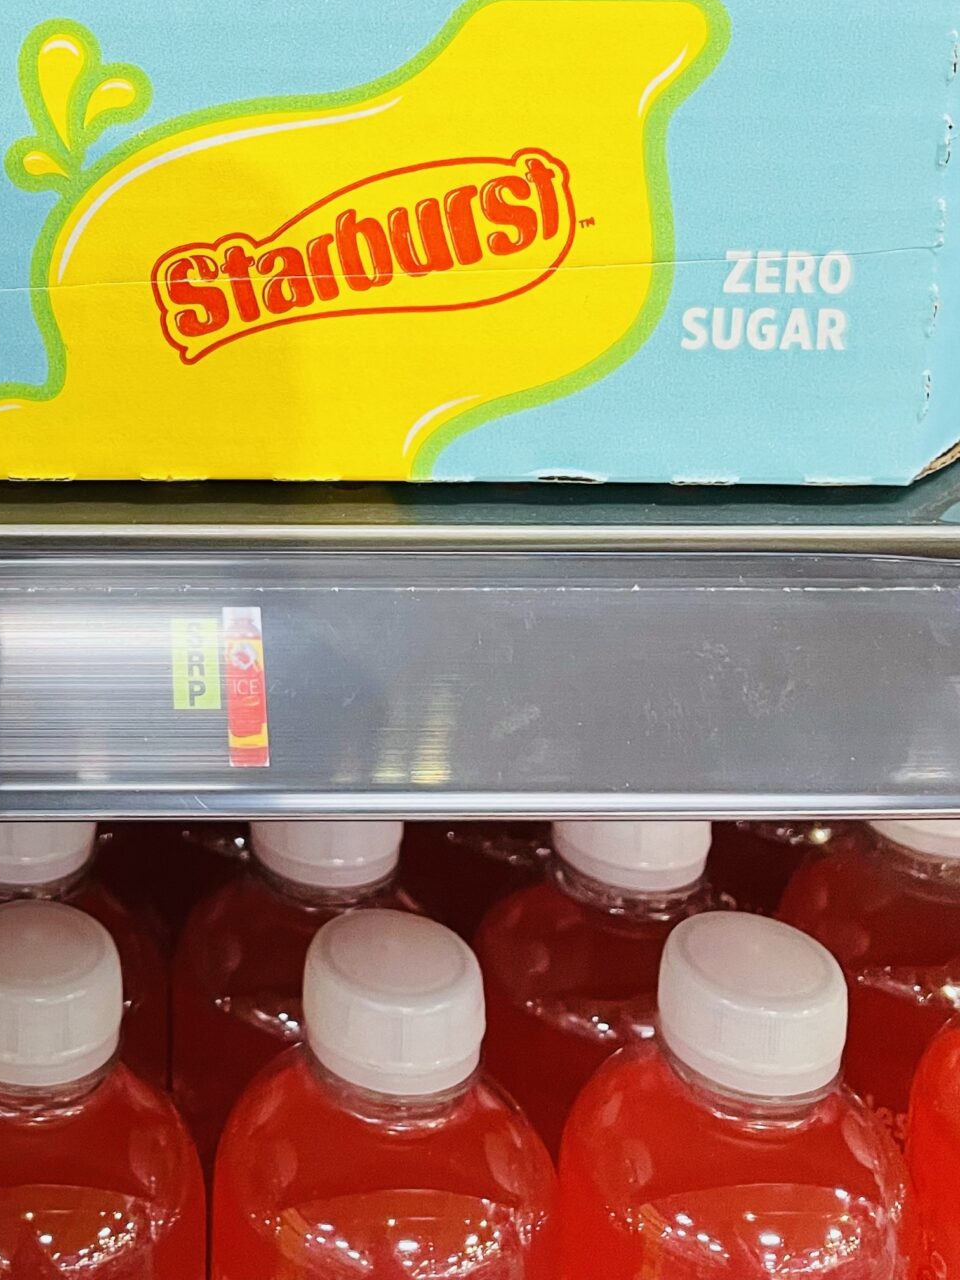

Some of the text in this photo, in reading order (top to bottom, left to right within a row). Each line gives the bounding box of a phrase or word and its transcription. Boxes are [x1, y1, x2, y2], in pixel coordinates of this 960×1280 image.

[165, 157, 563, 338] Starburst
[722, 249, 852, 296] ZERO
[680, 306, 847, 352] SUGAR
[233, 679, 259, 695] ICE
